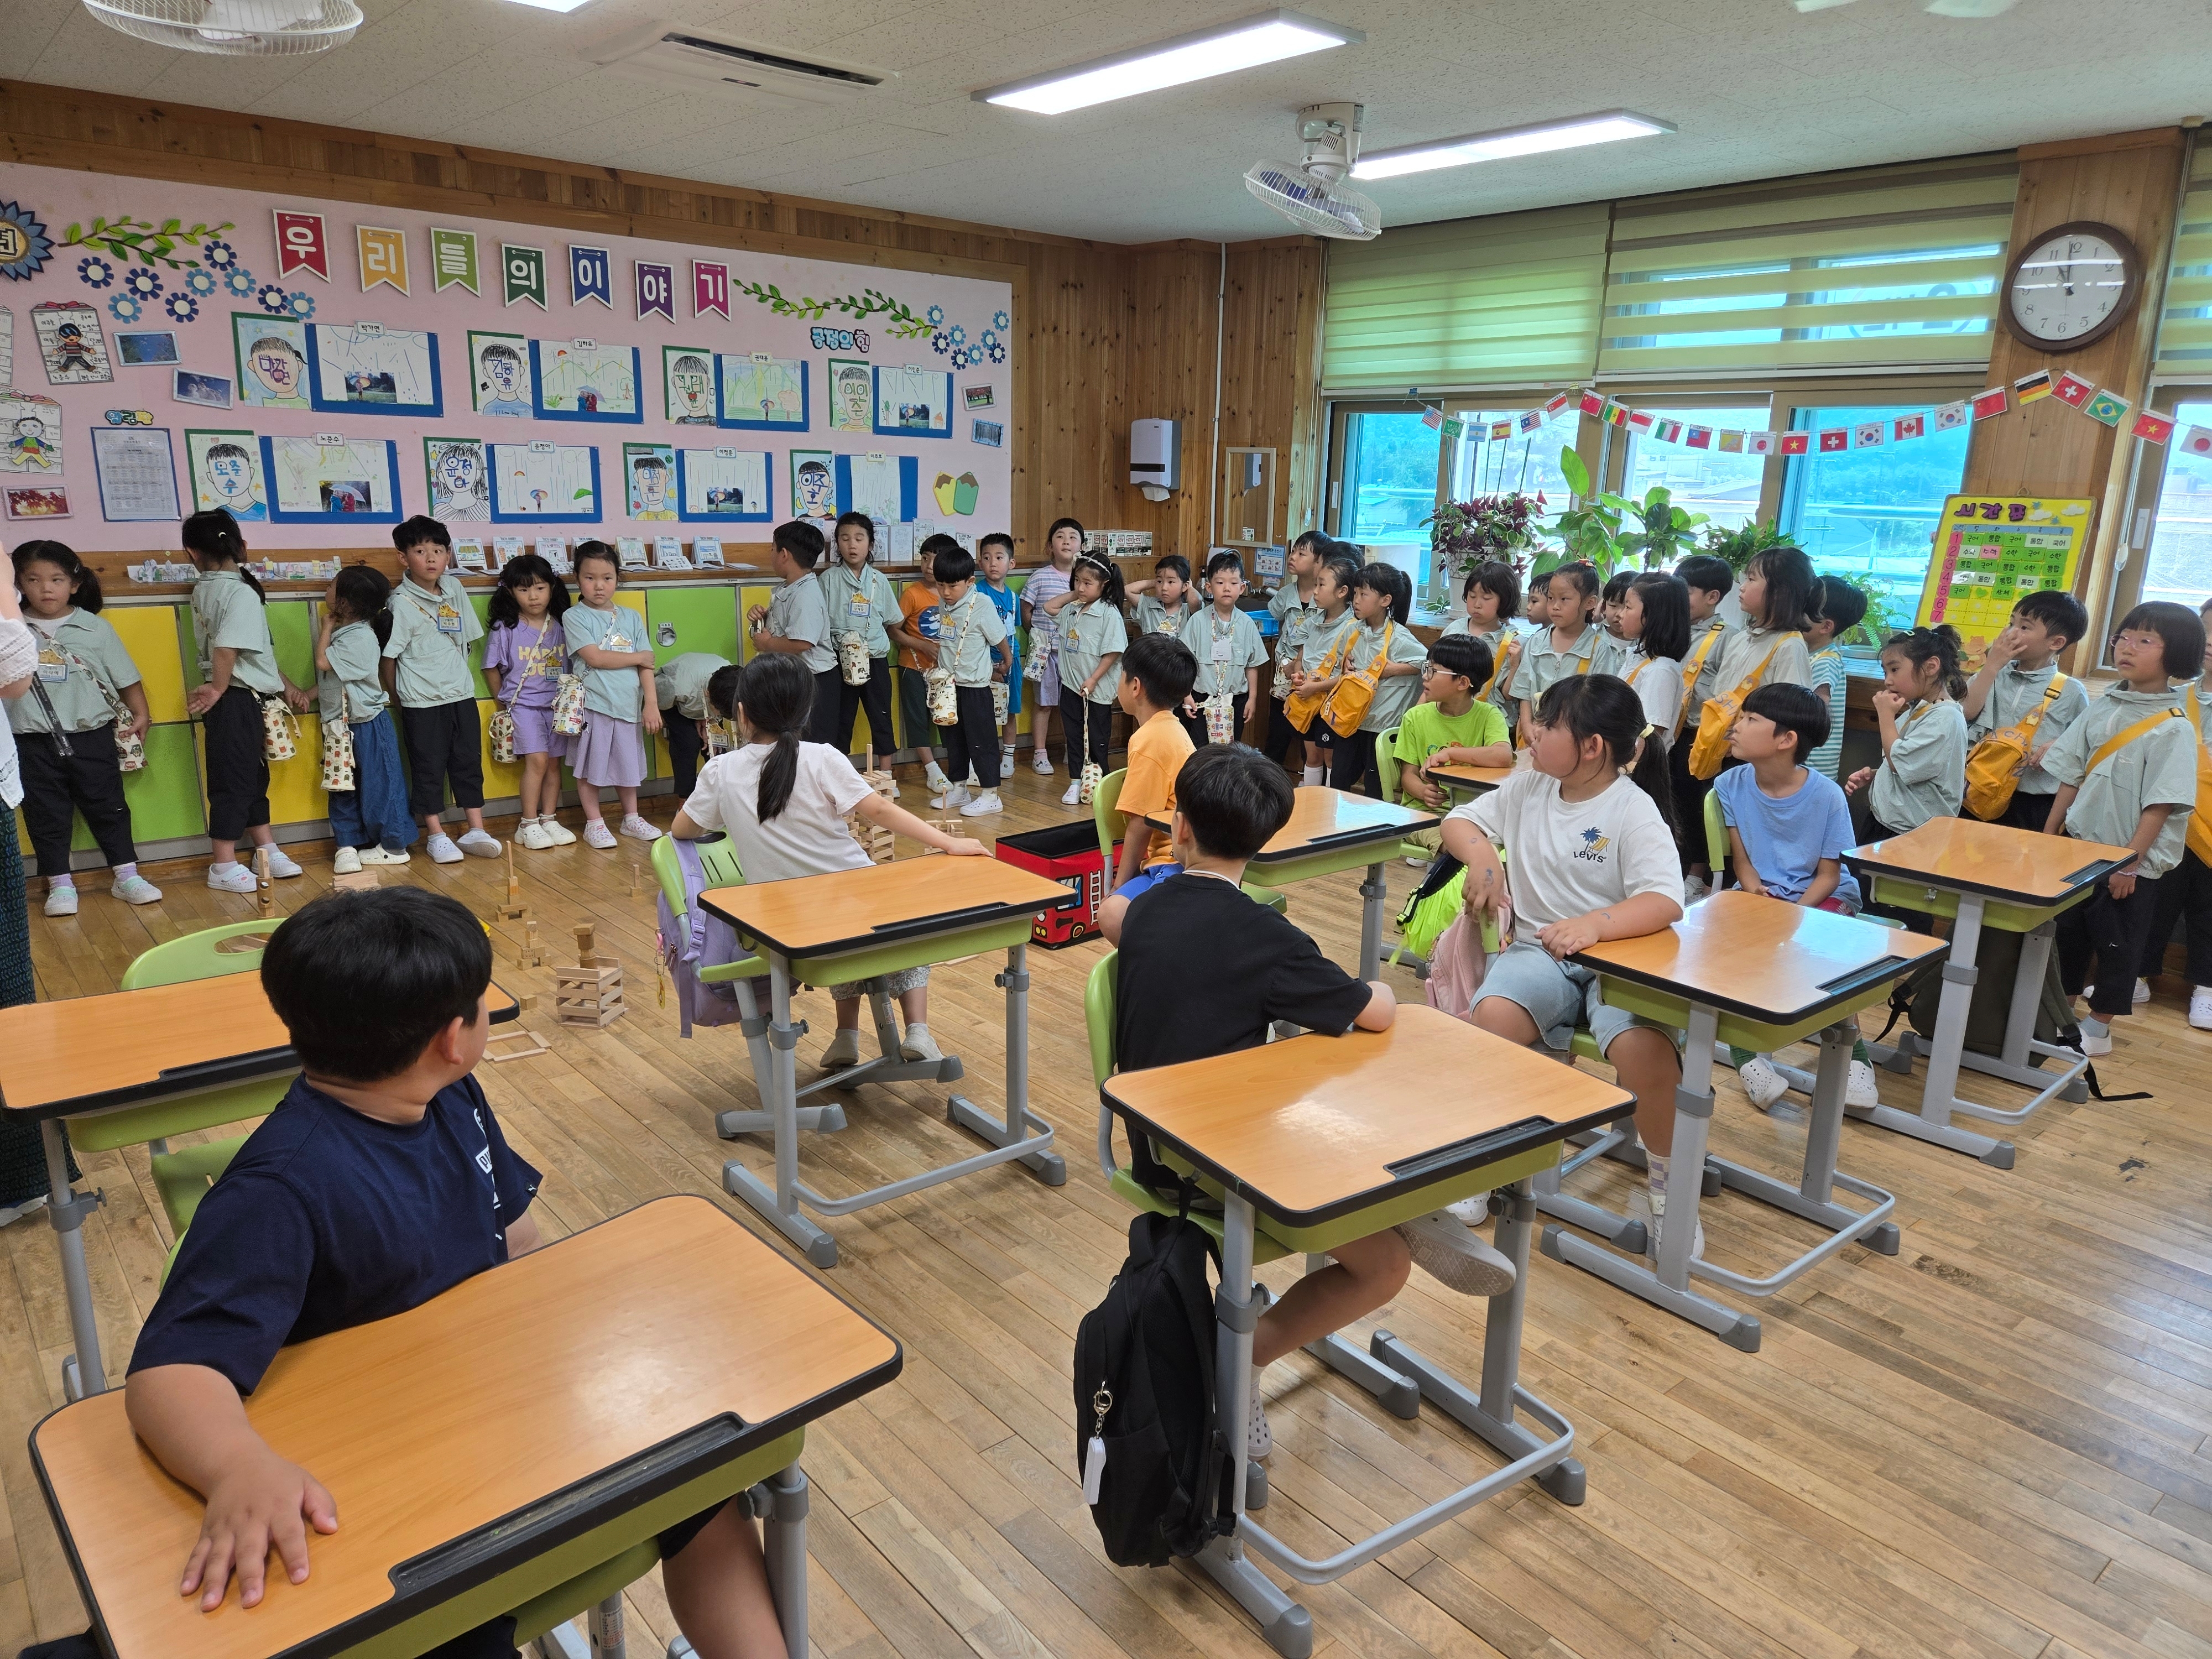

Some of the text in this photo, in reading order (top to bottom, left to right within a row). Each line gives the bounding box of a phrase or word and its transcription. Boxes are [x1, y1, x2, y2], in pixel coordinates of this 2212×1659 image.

[2070, 242, 2082, 254] 12
[2093, 247, 2099, 258] 1
[2049, 249, 2059, 260] 11
[2031, 266, 2043, 276] 10
[2025, 304, 2034, 316] 8
[2097, 301, 2107, 312] 4
[2041, 317, 2049, 328] 7
[2079, 316, 2089, 327] 5
[361, 325, 380, 333] 박가연
[2057, 322, 2067, 333] 6
[811, 327, 870, 353] 긍정의 힘
[1949, 546, 1957, 556] 2
[1945, 559, 1953, 570] 3
[2024, 565, 2036, 573] 수학
[1943, 572, 1950, 582] 4
[2000, 576, 2012, 585] 통합
[2044, 579, 2057, 587] 통합
[1939, 586, 1947, 596] 5
[1937, 598, 1944, 609] 6
[1934, 611, 1942, 621] 7
[519, 643, 565, 660] HAPY
